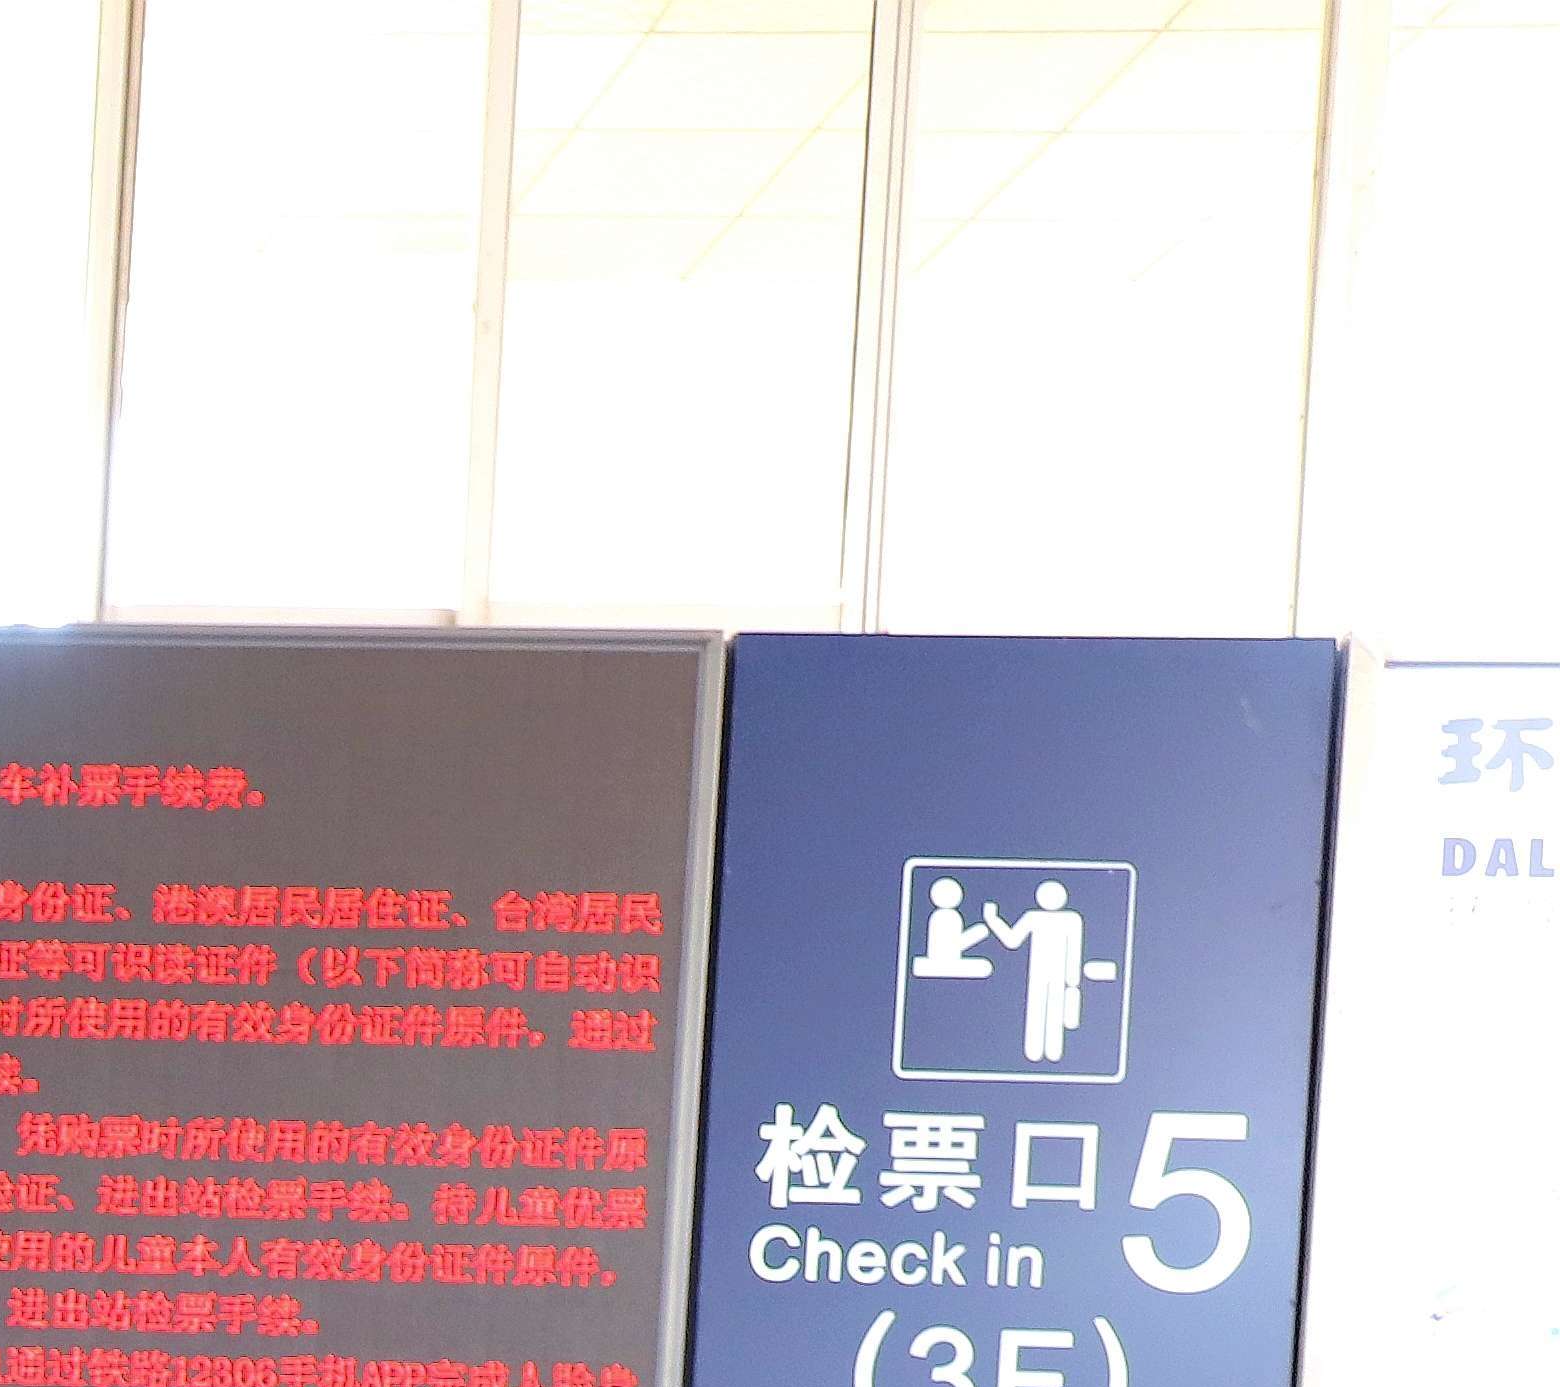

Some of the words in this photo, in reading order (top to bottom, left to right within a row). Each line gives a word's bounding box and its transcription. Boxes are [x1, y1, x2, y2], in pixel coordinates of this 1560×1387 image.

[748, 1222, 967, 1287] Check
[984, 1231, 1045, 1289] in
[755, 1102, 1100, 1212] 检票口
[1120, 1110, 1252, 1294] 5
